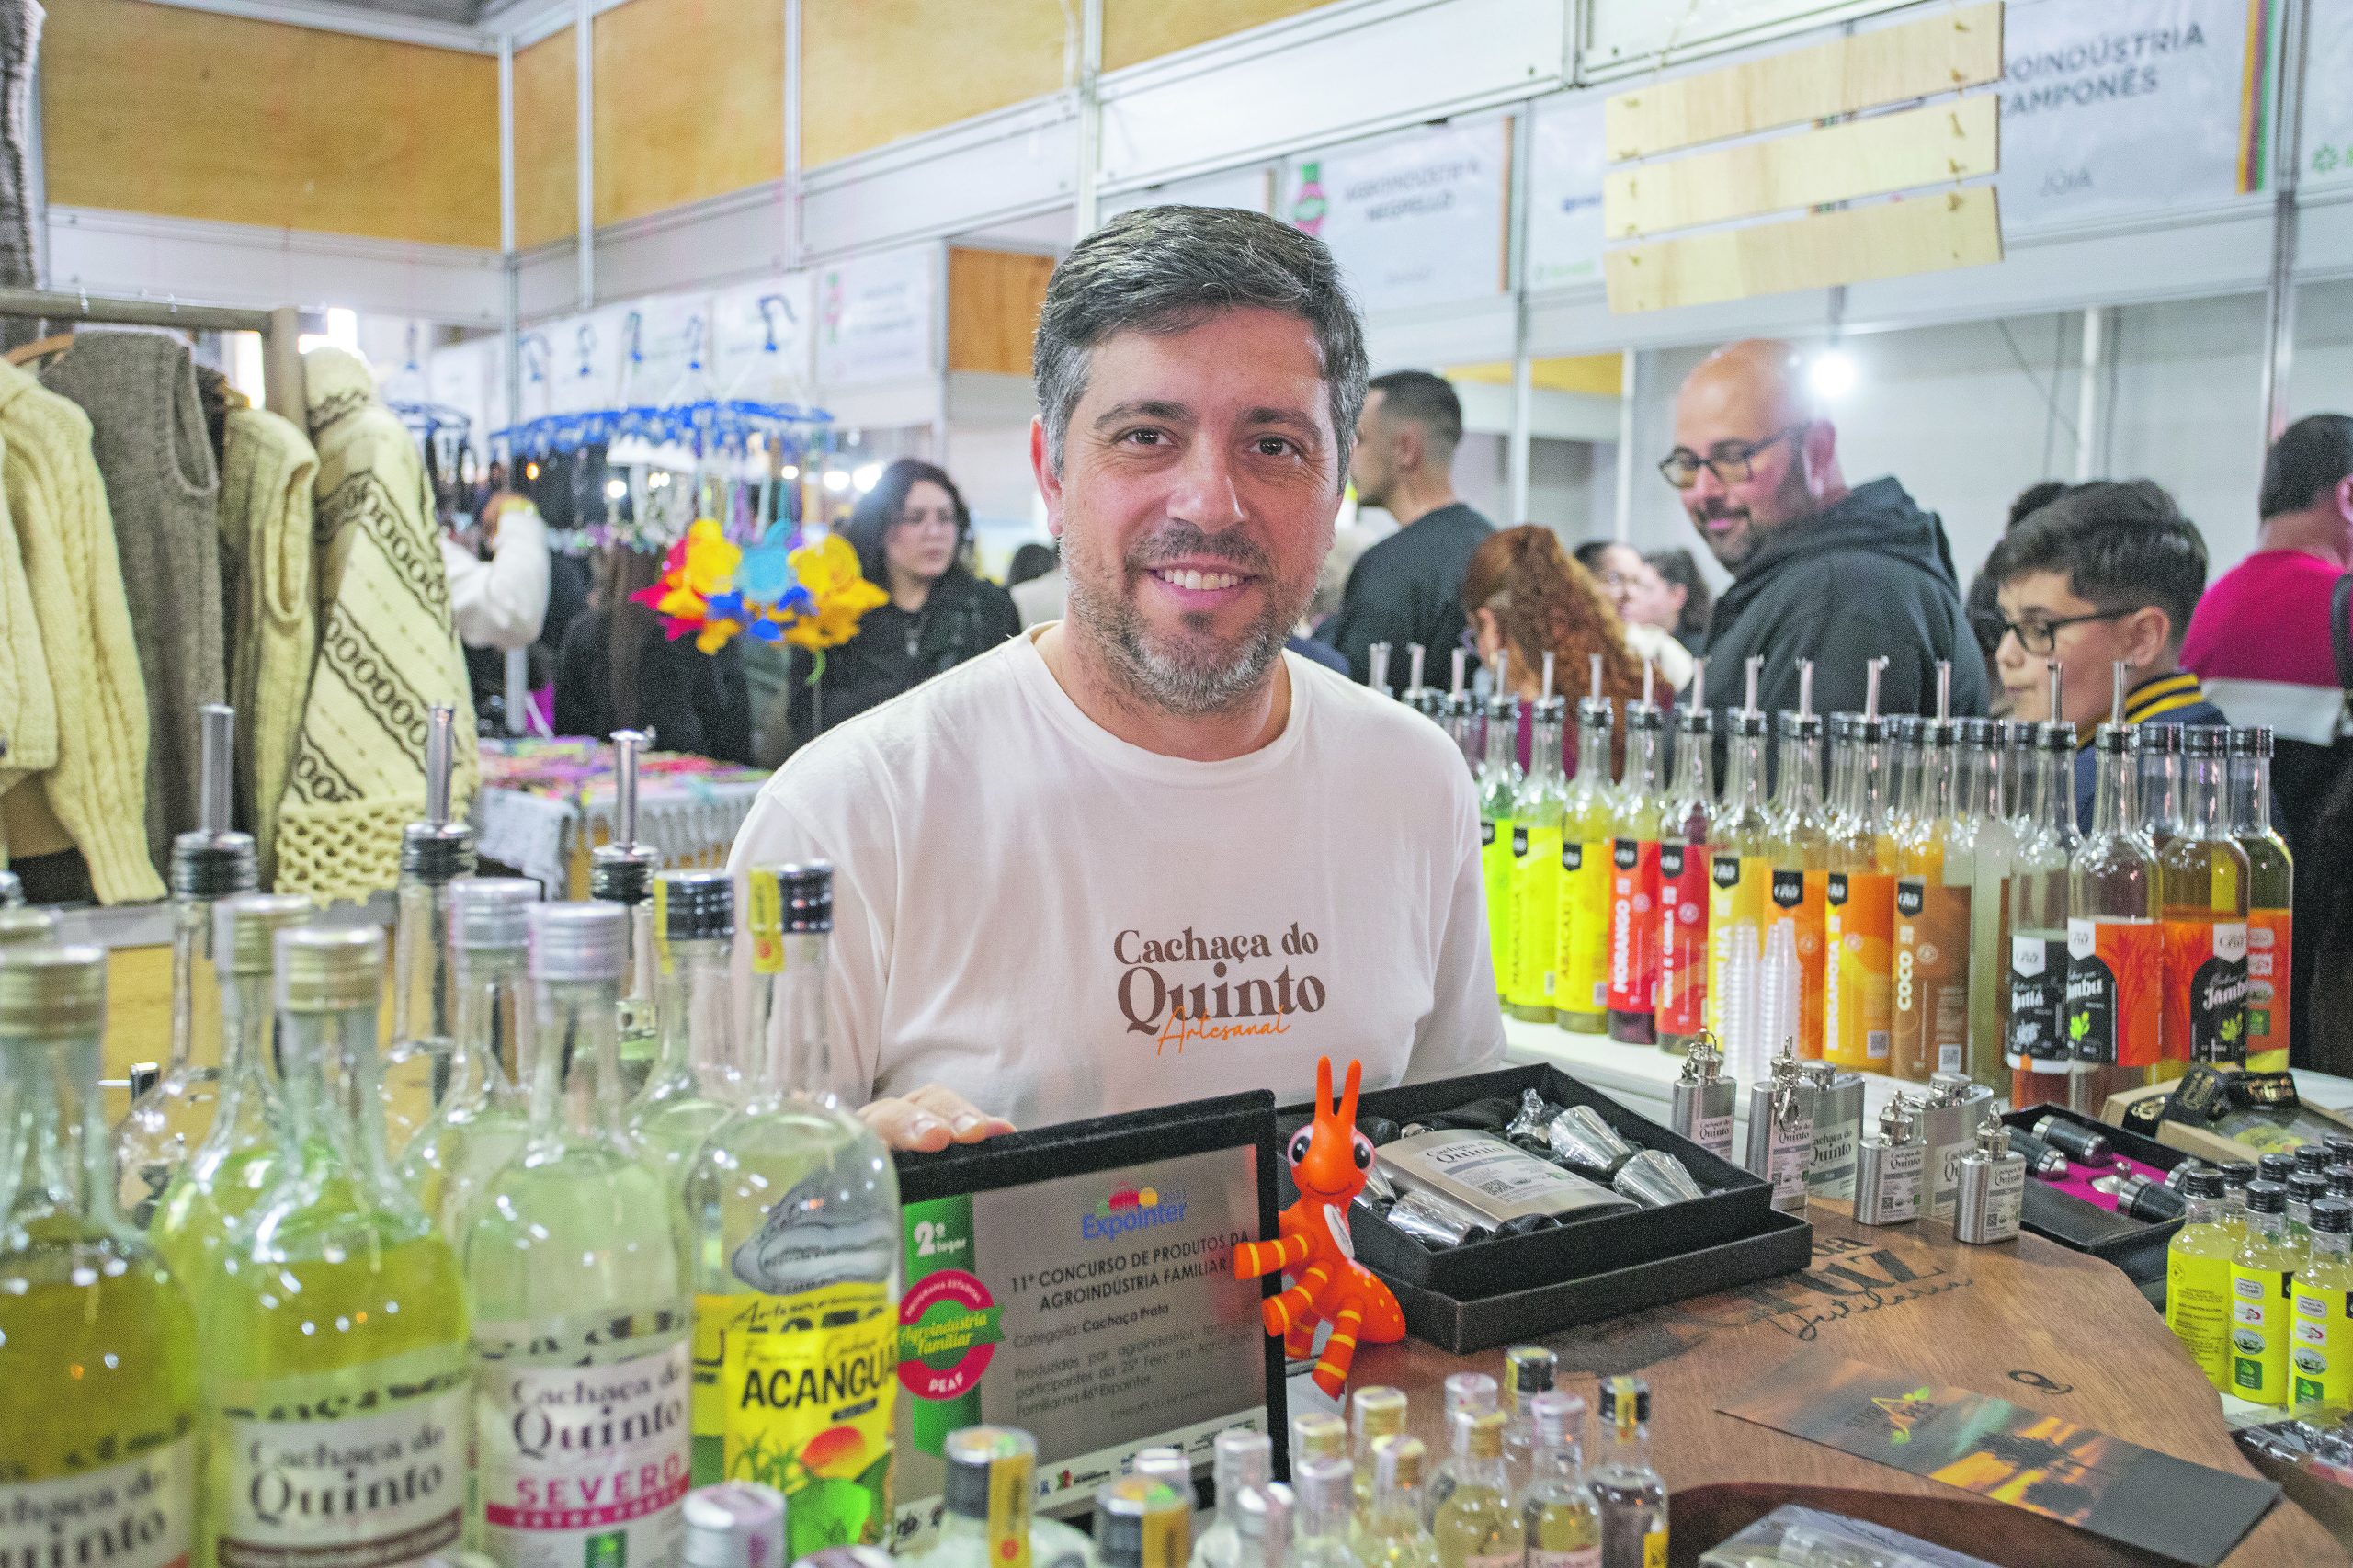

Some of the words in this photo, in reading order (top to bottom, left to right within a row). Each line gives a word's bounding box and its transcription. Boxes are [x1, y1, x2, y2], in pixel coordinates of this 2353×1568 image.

[2006, 22, 2206, 83] OINDÚSTRIA
[2004, 64, 2158, 119] AMPONÊS
[1113, 926, 1272, 965] Cachaça
[1281, 921, 1319, 956] do
[1613, 899, 1631, 993] MORANGO
[1117, 961, 1326, 1036] Quinto
[1897, 950, 1914, 1011] COCO
[1156, 1004, 1292, 1056] Artesanal
[1699, 1127, 1730, 1140] Quinto
[1779, 1130, 1810, 1143] Quinto
[1890, 1157, 1922, 1170] Quinto
[1082, 1203, 1187, 1242] Expointer
[1039, 1255, 1127, 1288] CONCURSO
[1131, 1250, 1149, 1269] DE
[1154, 1233, 1226, 1264] PRODUTOS
[1230, 1230, 1249, 1248] DA
[1039, 1272, 1160, 1312] AGROINDÚSTRIA
[1164, 1256, 1228, 1285] FAMILIAR
[1083, 1312, 1139, 1334] Cachaça
[1140, 1303, 1170, 1320] Prata
[928, 1370, 964, 1393] PEAF
[1016, 1371, 1093, 1400] participantes
[1088, 1350, 1108, 1367] por
[512, 1400, 683, 1460] Quinto
[249, 1465, 443, 1528] Quinto
[516, 1452, 681, 1509] SEVERO
[0, 1509, 166, 1568] uinto
